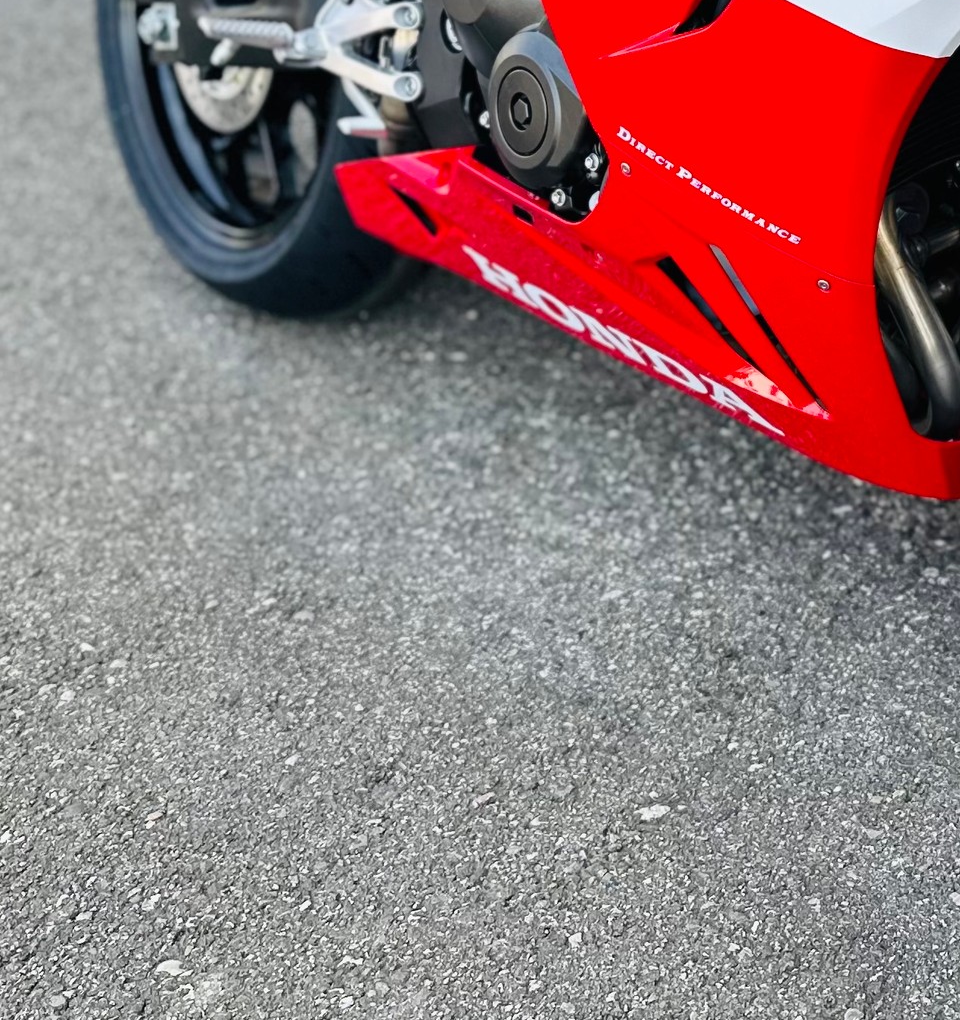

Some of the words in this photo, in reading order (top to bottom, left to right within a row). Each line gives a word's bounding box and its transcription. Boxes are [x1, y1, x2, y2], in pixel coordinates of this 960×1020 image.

[616, 126, 674, 170] DIRECT
[676, 166, 801, 245] PERFORMANCE
[462, 245, 785, 436] HONDA
